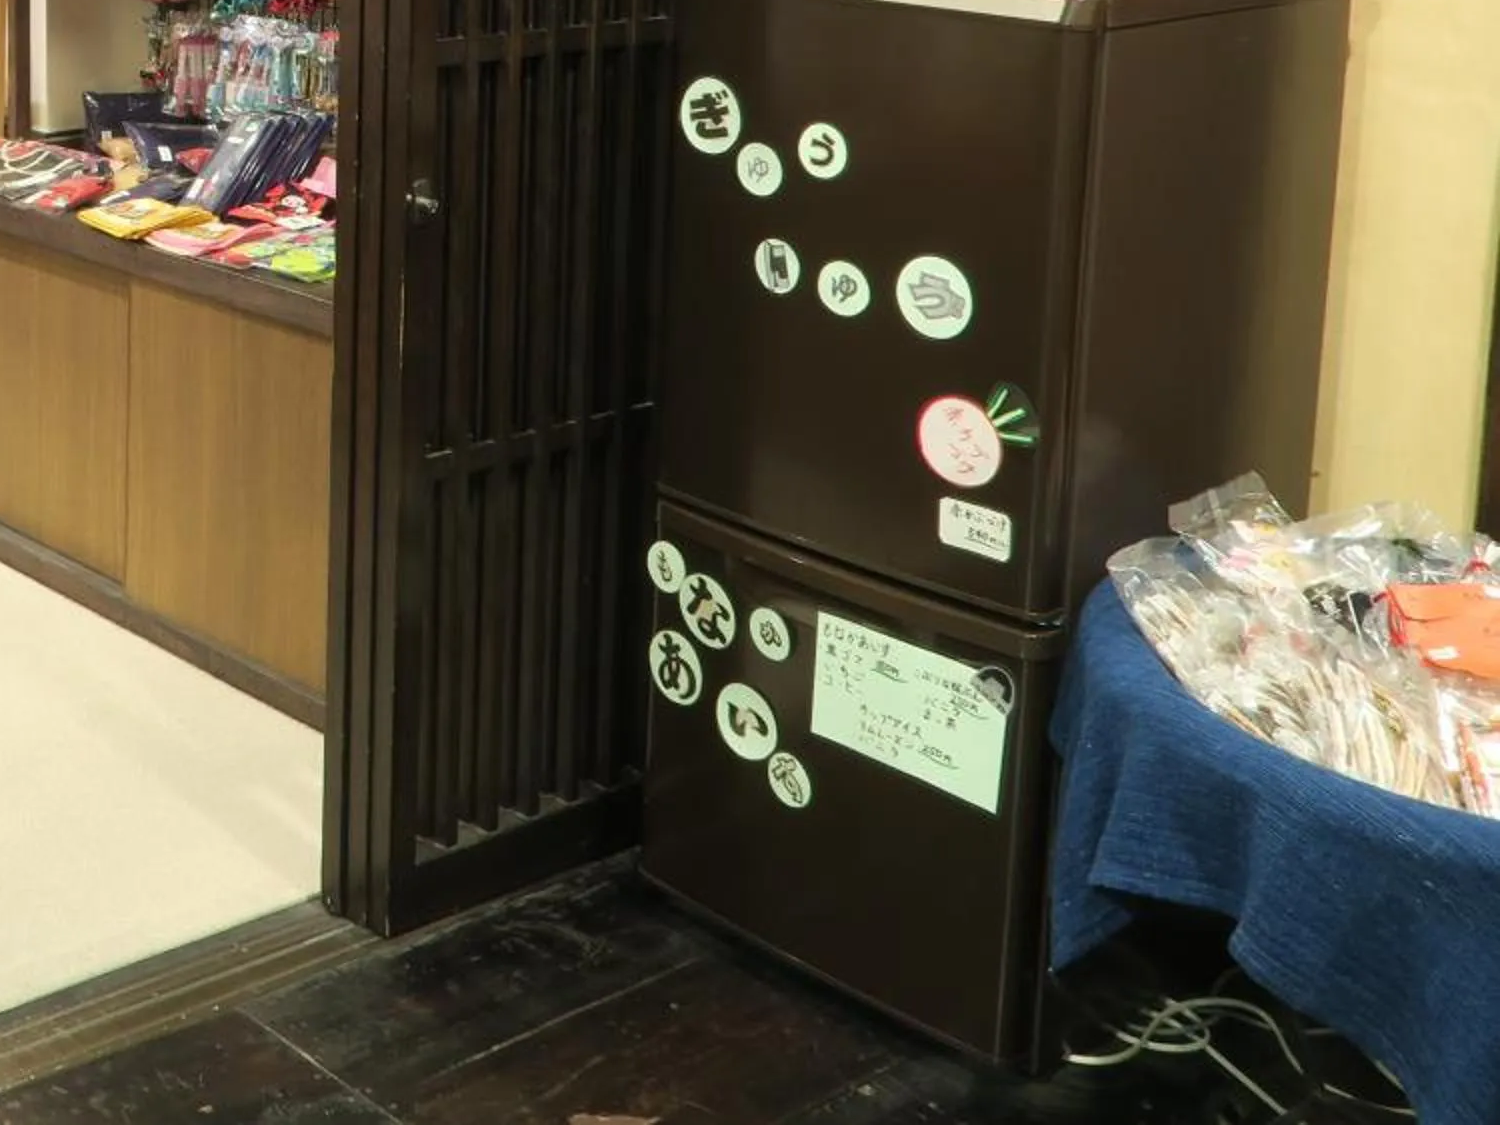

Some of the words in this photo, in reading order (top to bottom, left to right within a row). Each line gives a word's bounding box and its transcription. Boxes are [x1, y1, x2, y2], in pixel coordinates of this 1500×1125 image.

[690, 89, 730, 140] ぎ
[809, 132, 836, 167] う
[657, 632, 697, 700] あ
